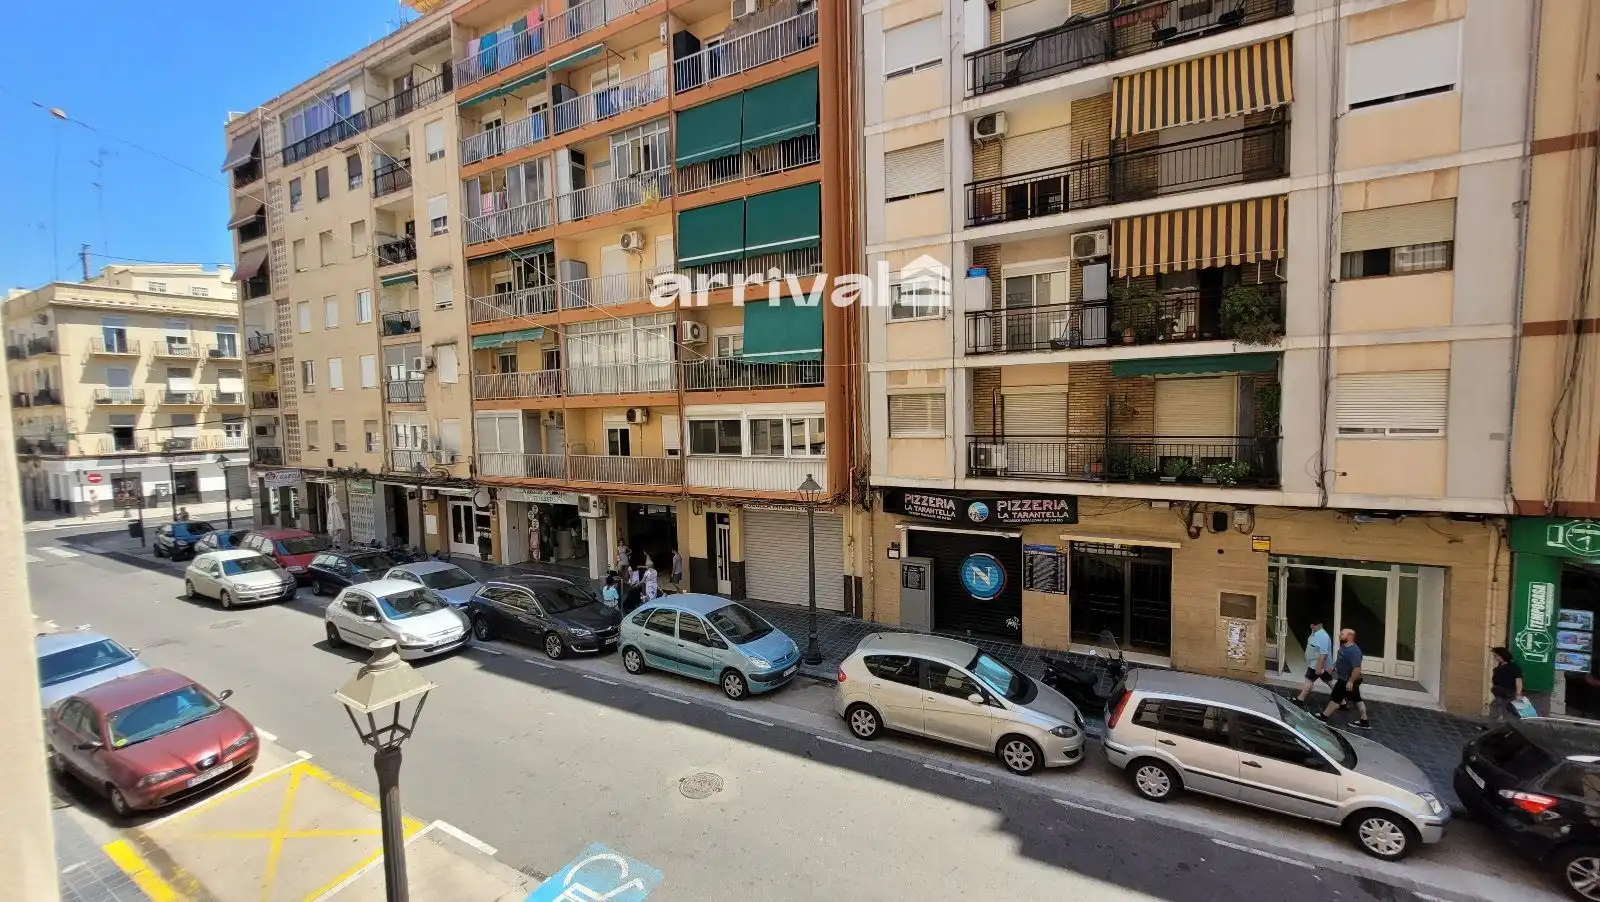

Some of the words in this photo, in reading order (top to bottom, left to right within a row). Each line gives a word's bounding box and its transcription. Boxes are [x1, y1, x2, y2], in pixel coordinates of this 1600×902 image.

[905, 493, 956, 510] PIZZERIA
[996, 500, 1069, 511] PIZZERIA
[913, 505, 956, 518] TARANTELLA
[1012, 511, 1069, 519] TARANTELLA
[1529, 584, 1547, 629] TEMPOCASA
